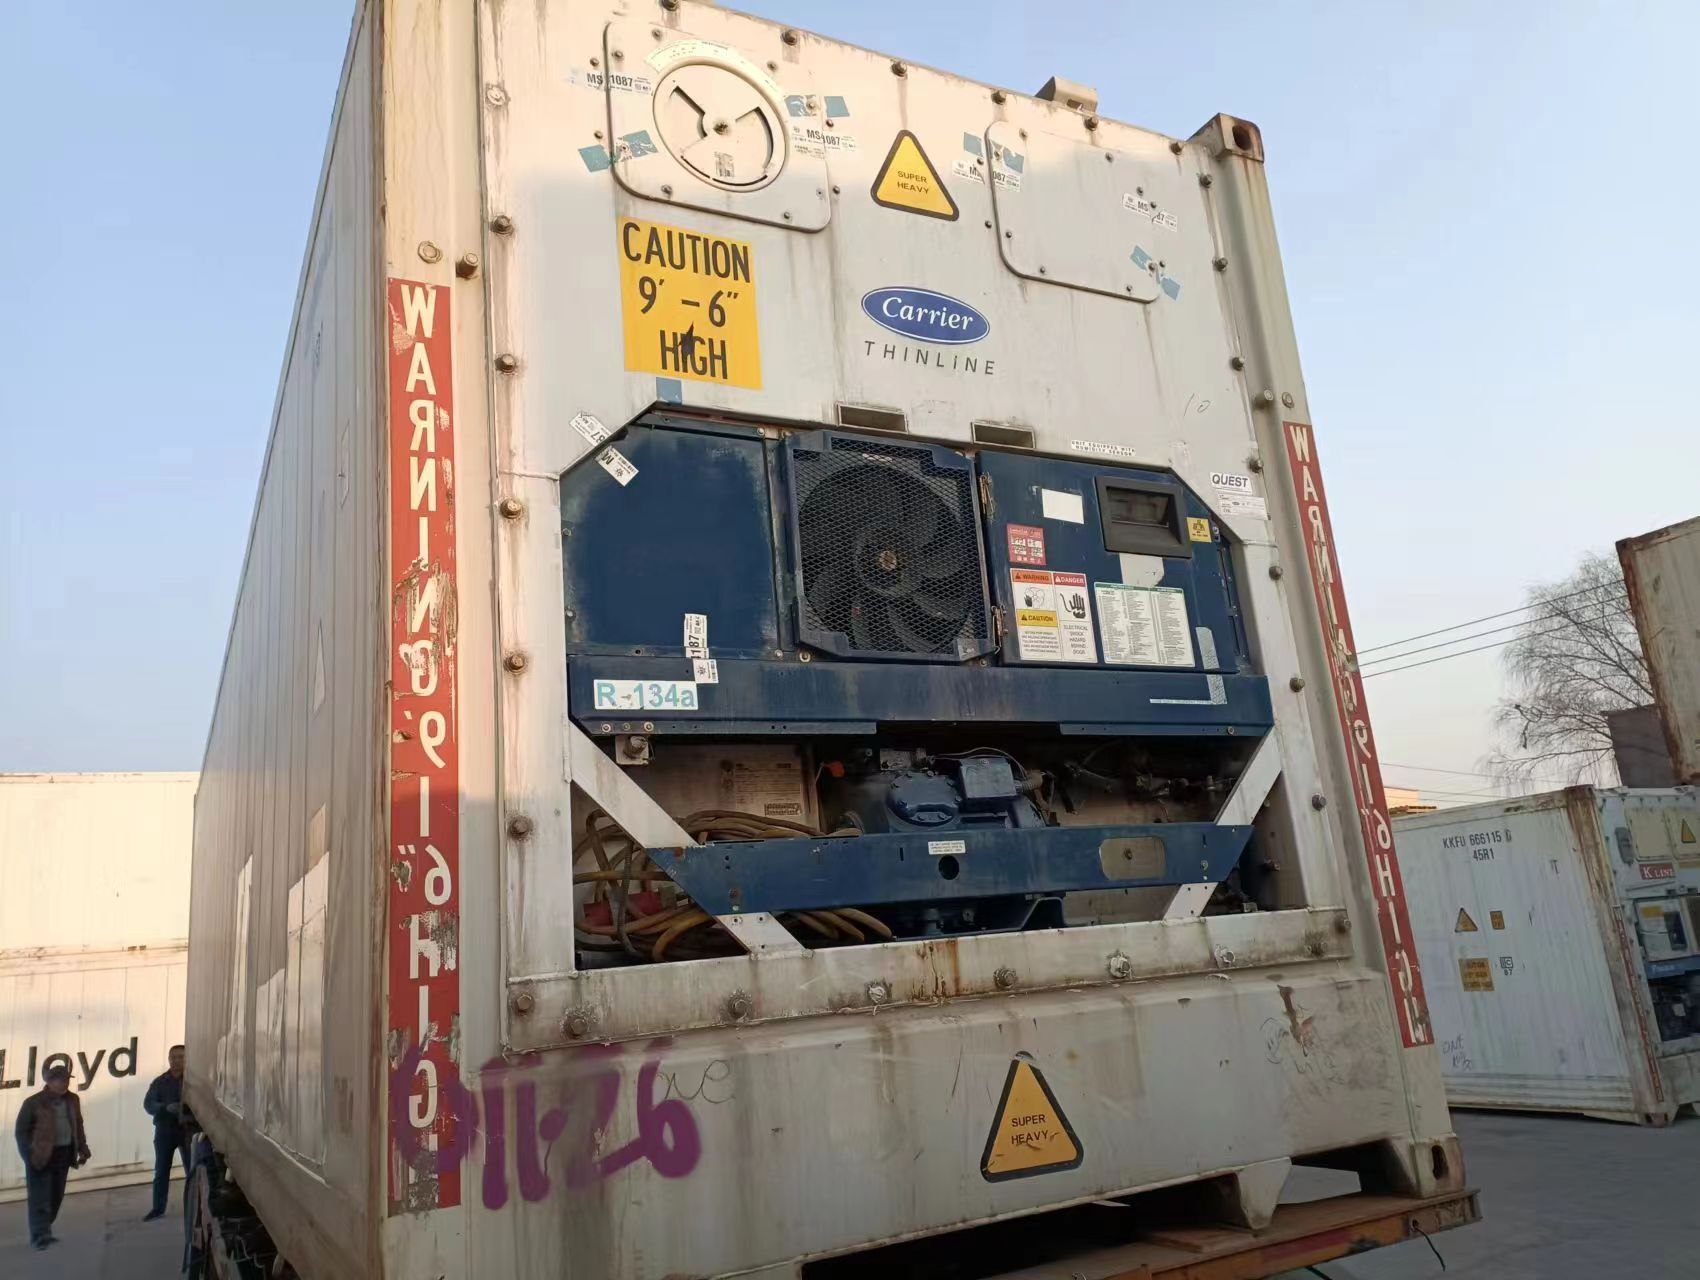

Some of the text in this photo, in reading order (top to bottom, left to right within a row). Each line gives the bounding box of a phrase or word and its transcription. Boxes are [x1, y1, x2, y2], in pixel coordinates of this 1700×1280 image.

[898, 170, 927, 183] SUPER
[897, 181, 929, 194] HEAVY
[623, 222, 750, 283] CAUTION
[639, 276, 665, 314] 9'
[709, 290, 739, 327] 6"
[882, 297, 973, 330] Carrier
[659, 329, 728, 379] HIGH
[1212, 473, 1248, 487] QUEST
[1442, 836, 1466, 848] KKFU
[1469, 831, 1502, 846] 666115
[1473, 848, 1495, 861] 45R1
[0, 1037, 138, 1091] Lloyd
[1011, 1113, 1046, 1128] SUPER
[1011, 1130, 1049, 1145] HEAVY
